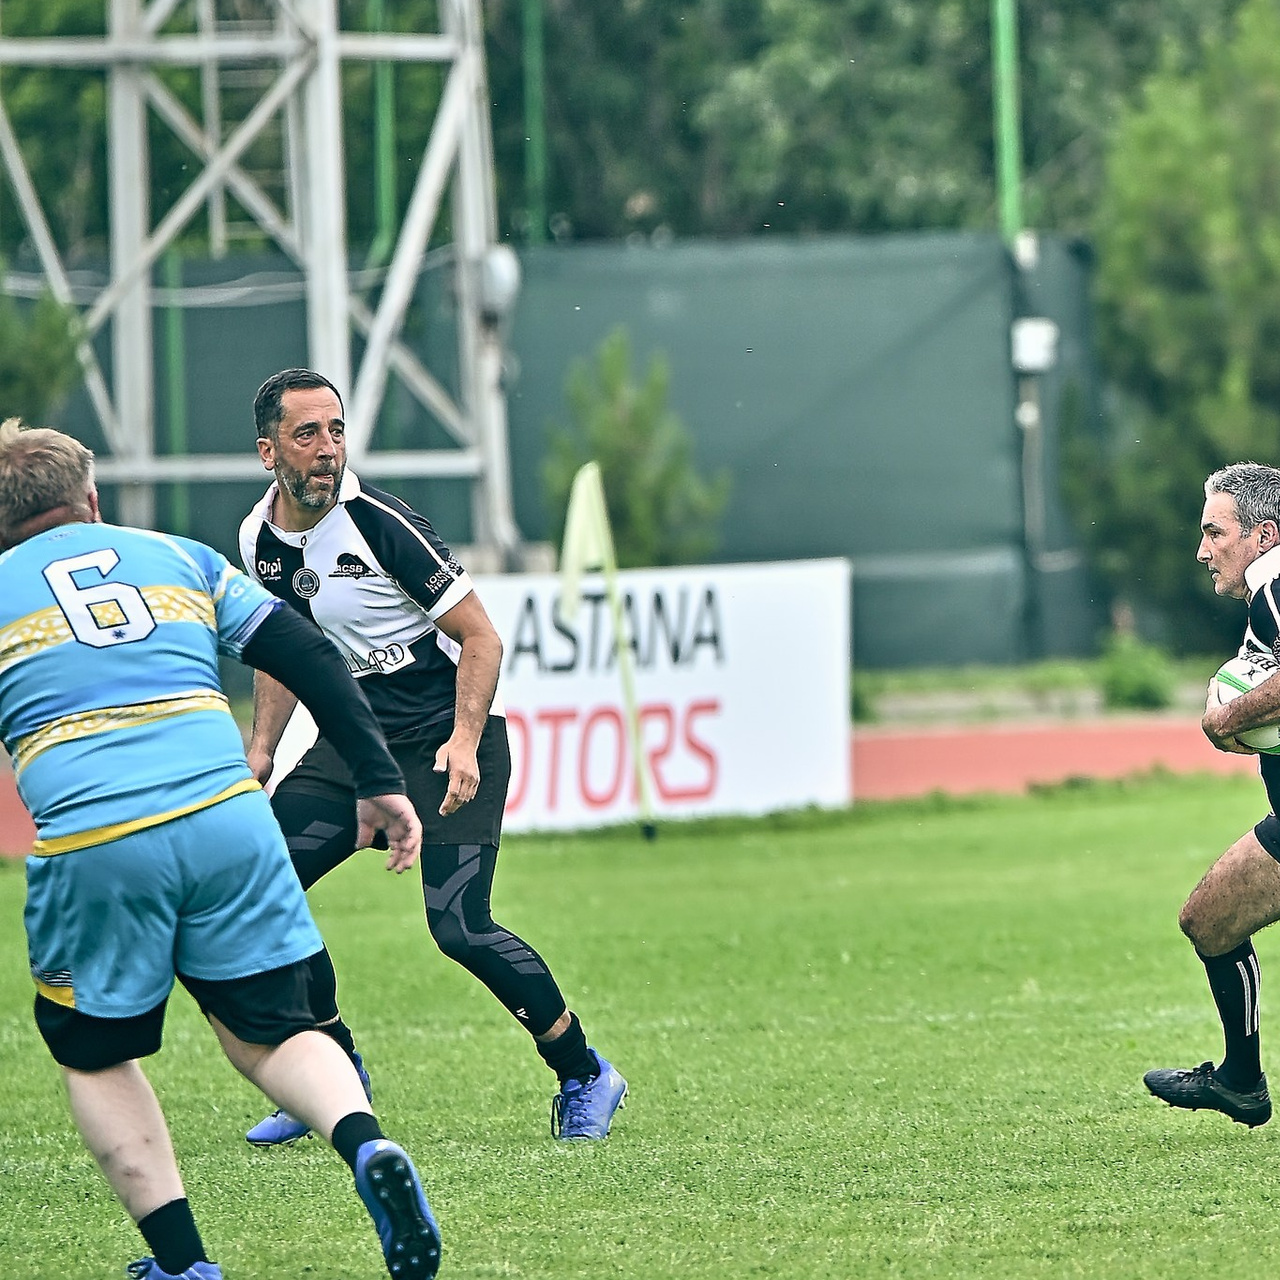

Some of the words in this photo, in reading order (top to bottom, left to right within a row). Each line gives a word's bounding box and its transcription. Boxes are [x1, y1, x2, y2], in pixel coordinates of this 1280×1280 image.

[42, 547, 157, 649] 6
[506, 583, 725, 675] ASTANA
[505, 697, 722, 814] OTORS
